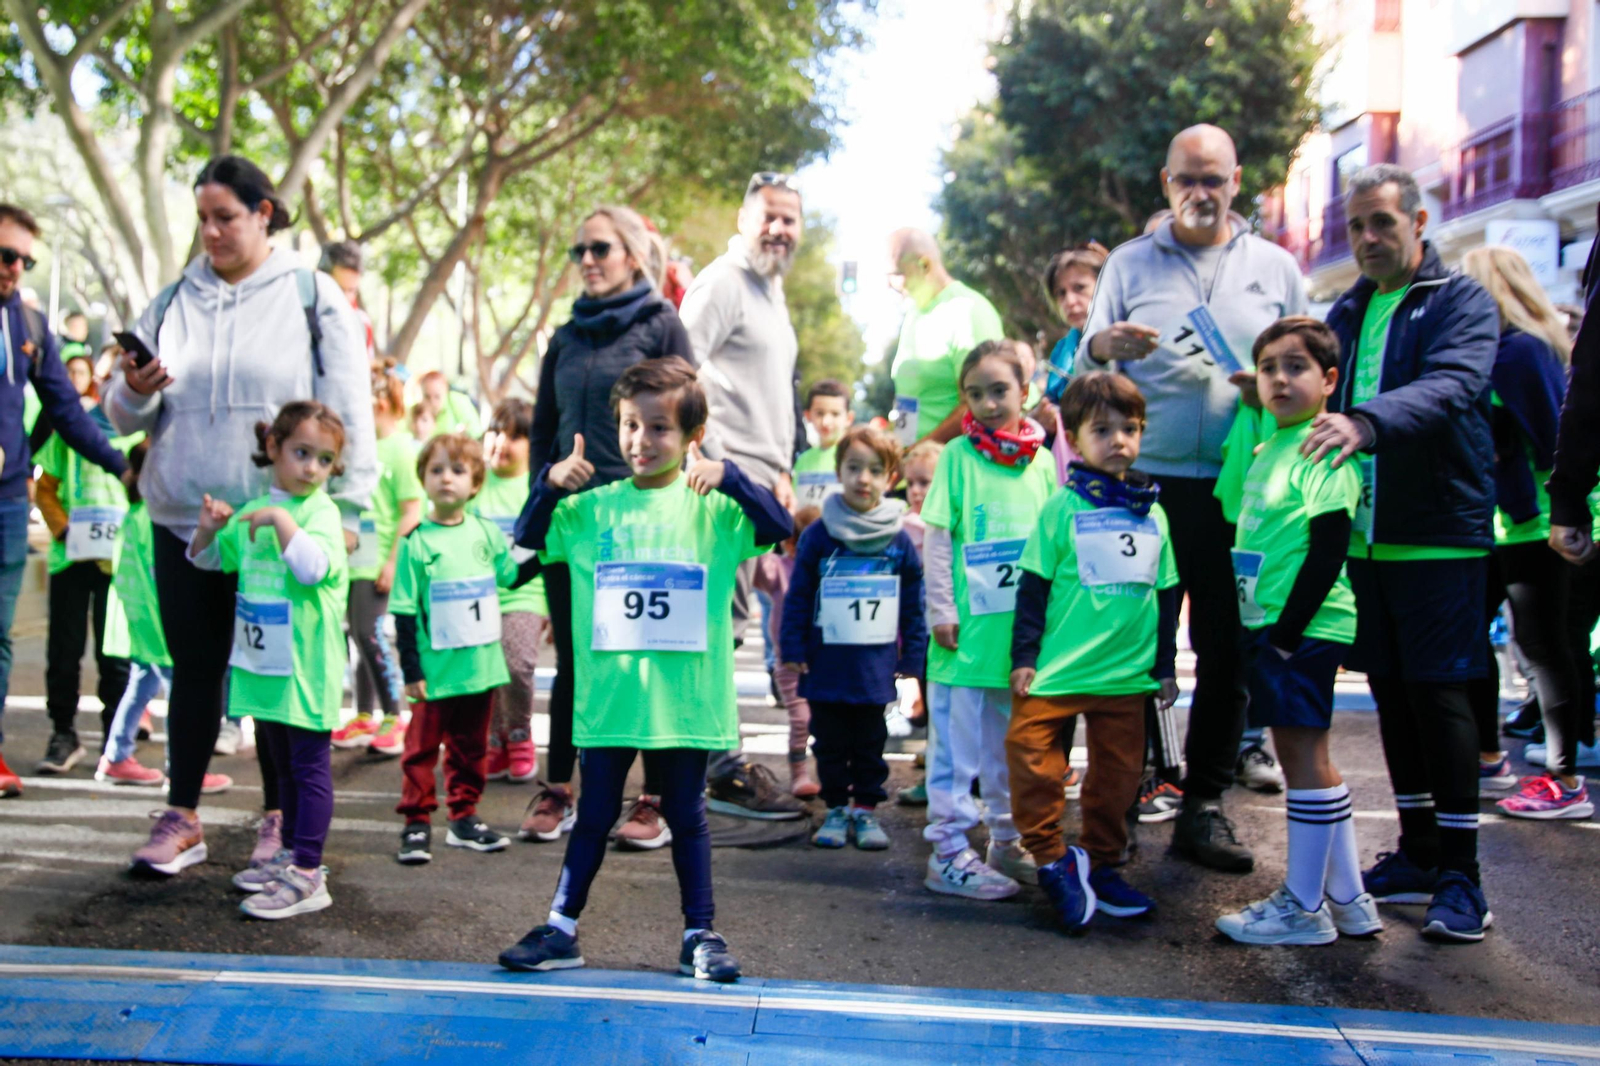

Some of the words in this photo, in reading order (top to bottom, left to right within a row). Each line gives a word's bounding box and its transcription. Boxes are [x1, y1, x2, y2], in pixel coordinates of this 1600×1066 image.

[805, 484, 826, 499] 47
[89, 522, 118, 540] 58
[1119, 532, 1137, 557] 3
[468, 599, 481, 621] 1
[623, 590, 671, 620] 95
[848, 599, 881, 621] 17
[243, 622, 266, 650] 12
